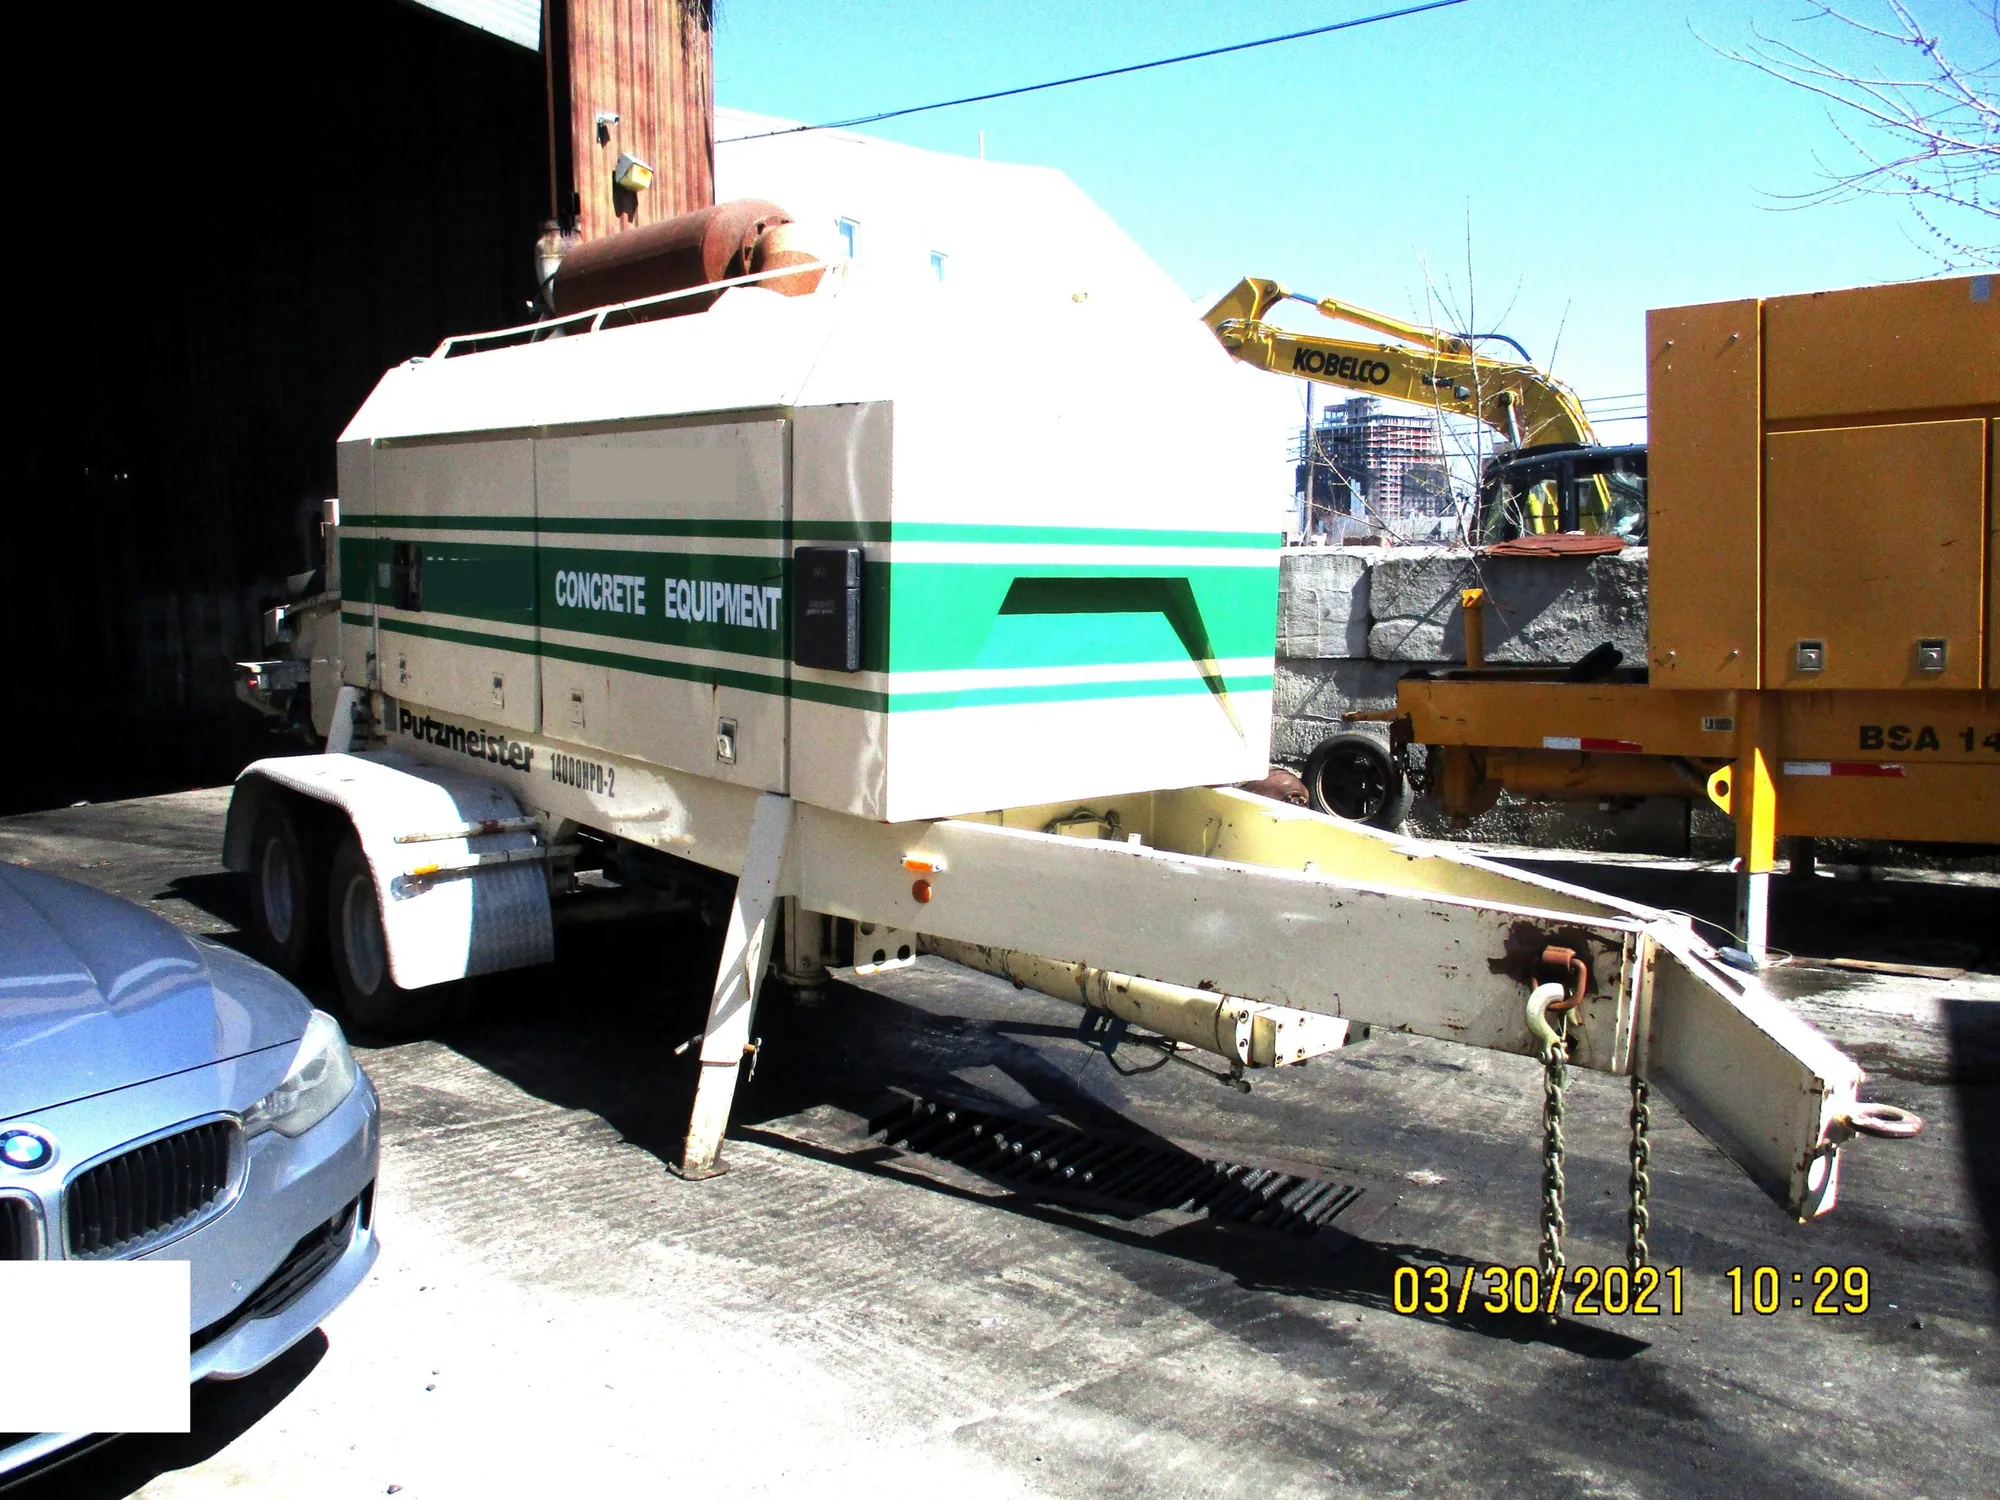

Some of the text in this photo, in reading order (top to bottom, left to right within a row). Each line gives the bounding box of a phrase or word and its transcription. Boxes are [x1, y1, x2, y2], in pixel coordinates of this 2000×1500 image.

[1292, 347, 1390, 385] KOBELCO
[555, 570, 782, 631] CONCRETE EQUIPMENT
[399, 707, 535, 773] Putzmeister
[1860, 724, 1940, 752] BSA
